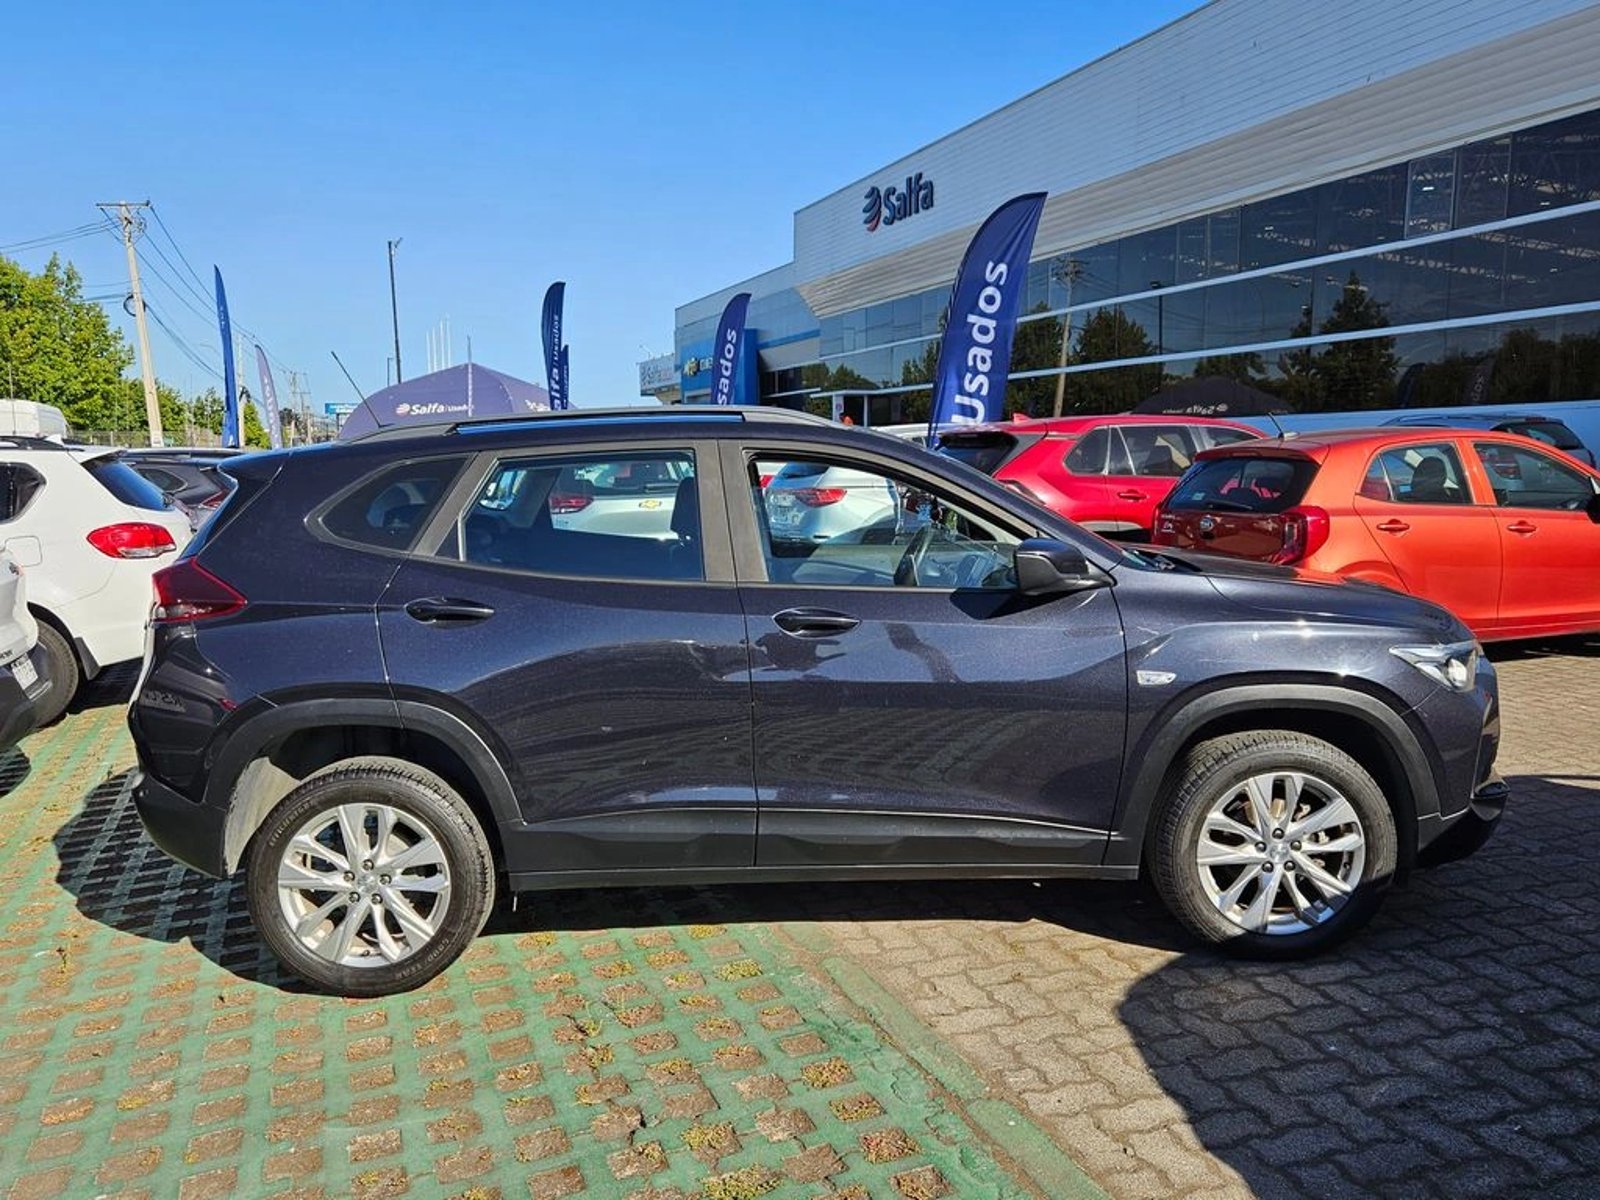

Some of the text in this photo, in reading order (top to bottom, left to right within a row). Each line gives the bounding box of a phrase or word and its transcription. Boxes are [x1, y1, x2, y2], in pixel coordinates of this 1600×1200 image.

[883, 172, 933, 225] Salfa
[717, 328, 737, 406] sados
[952, 260, 1008, 426] Usados
[410, 402, 445, 415] Salfa
